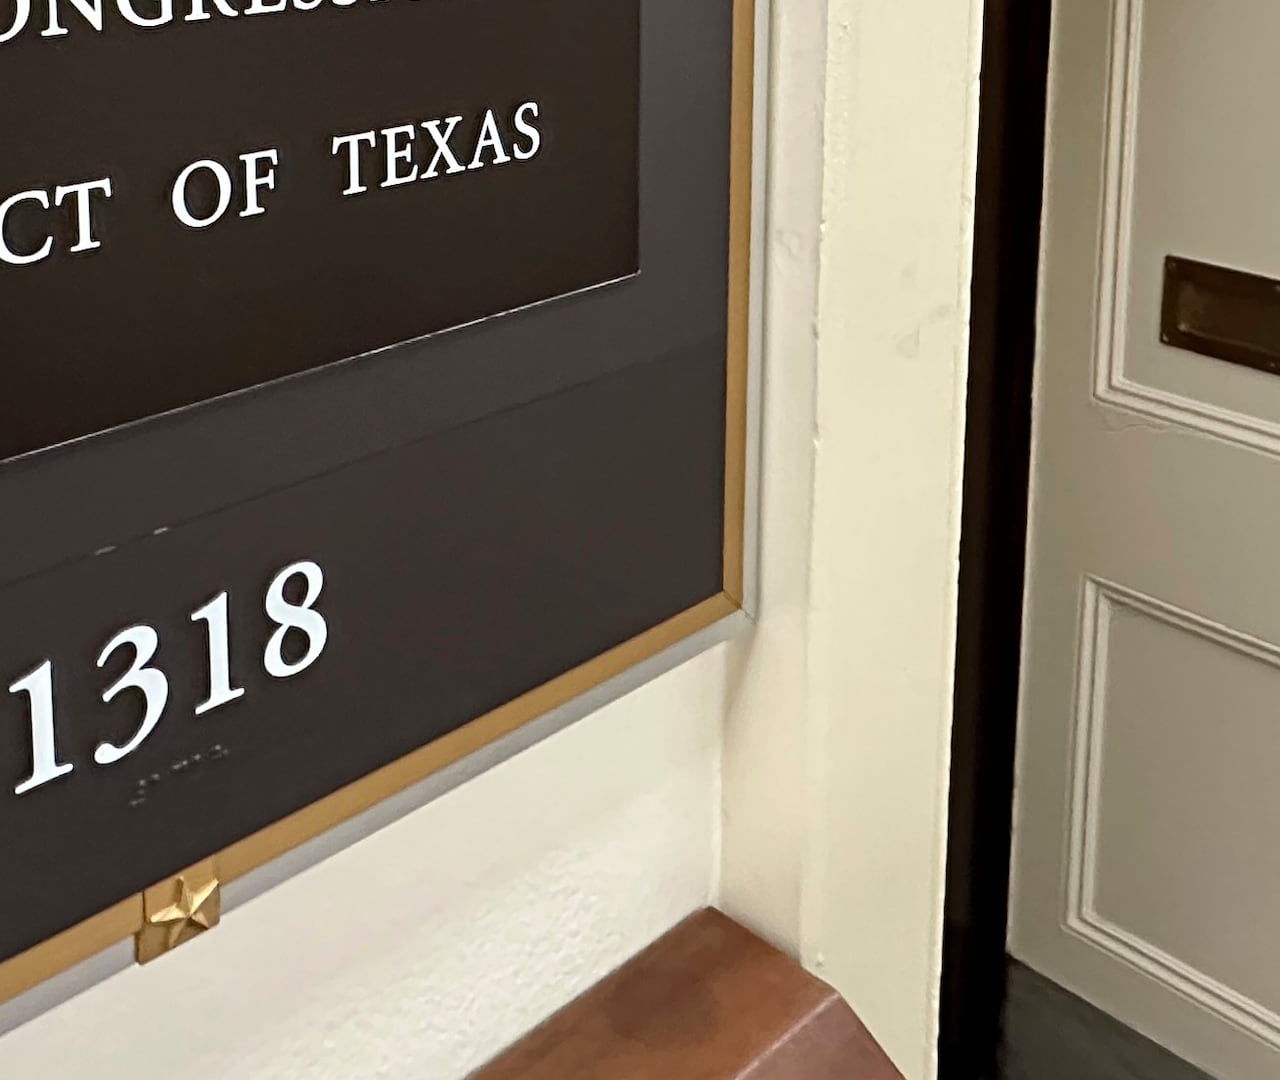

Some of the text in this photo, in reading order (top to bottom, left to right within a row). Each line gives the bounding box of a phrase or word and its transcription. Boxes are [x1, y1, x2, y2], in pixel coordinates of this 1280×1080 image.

[171, 148, 278, 228] OF
[331, 102, 540, 196] TEXAS
[8, 560, 329, 796] 1318
